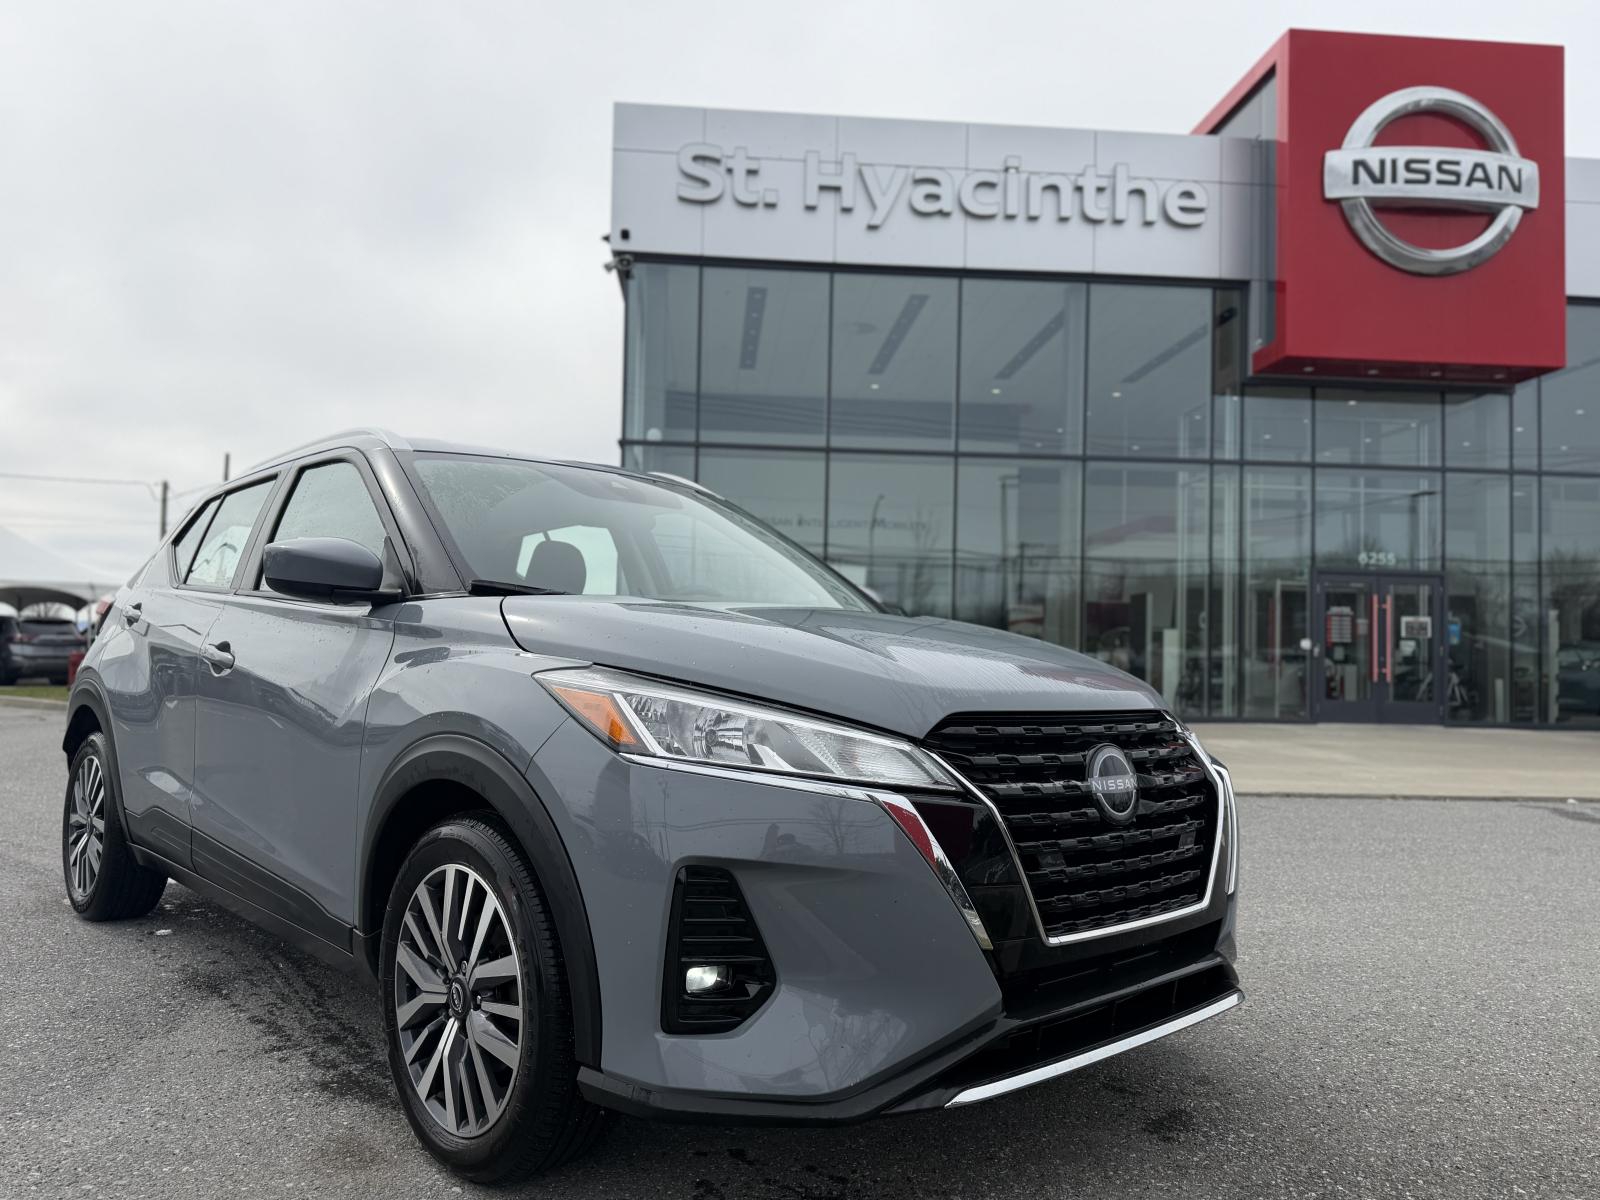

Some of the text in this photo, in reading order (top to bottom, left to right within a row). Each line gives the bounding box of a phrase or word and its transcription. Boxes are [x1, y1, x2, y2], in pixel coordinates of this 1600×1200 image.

[677, 142, 1209, 230] St. Hyacinthe
[1352, 157, 1523, 194] NISSAN
[1358, 552, 1396, 566] 6255
[1092, 778, 1137, 791] NISSAN
